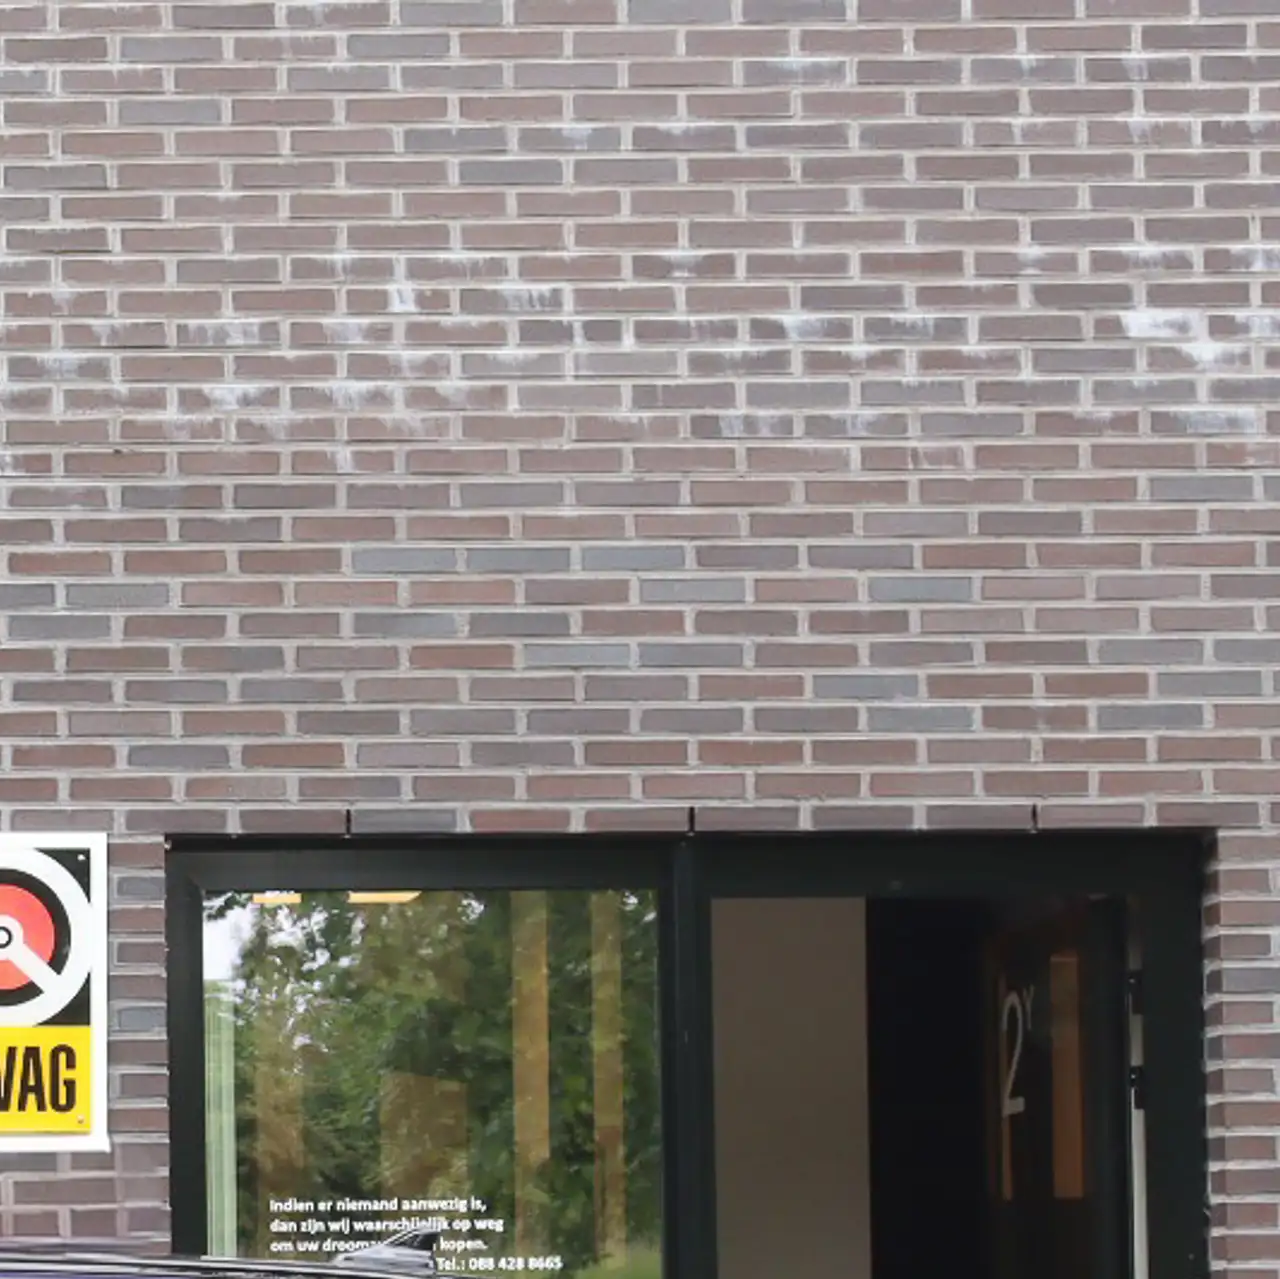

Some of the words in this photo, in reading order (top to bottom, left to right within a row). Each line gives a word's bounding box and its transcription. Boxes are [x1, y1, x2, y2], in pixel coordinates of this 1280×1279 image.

[269, 1197, 314, 1212] Indien
[317, 1200, 333, 1211] er
[336, 1197, 399, 1212] niemand
[401, 1198, 467, 1212] aanwezig
[470, 1196, 487, 1212] is,
[269, 1218, 297, 1233] dan
[300, 1218, 326, 1235] zijn
[327, 1217, 350, 1235] wij
[452, 1219, 472, 1232] op
[474, 1218, 504, 1233] weg
[269, 1240, 294, 1252] om
[296, 1240, 320, 1252] uw
[322, 1237, 384, 1252] droom
[440, 1236, 488, 1253] kopen.
[497, 1256, 525, 1271] 428
